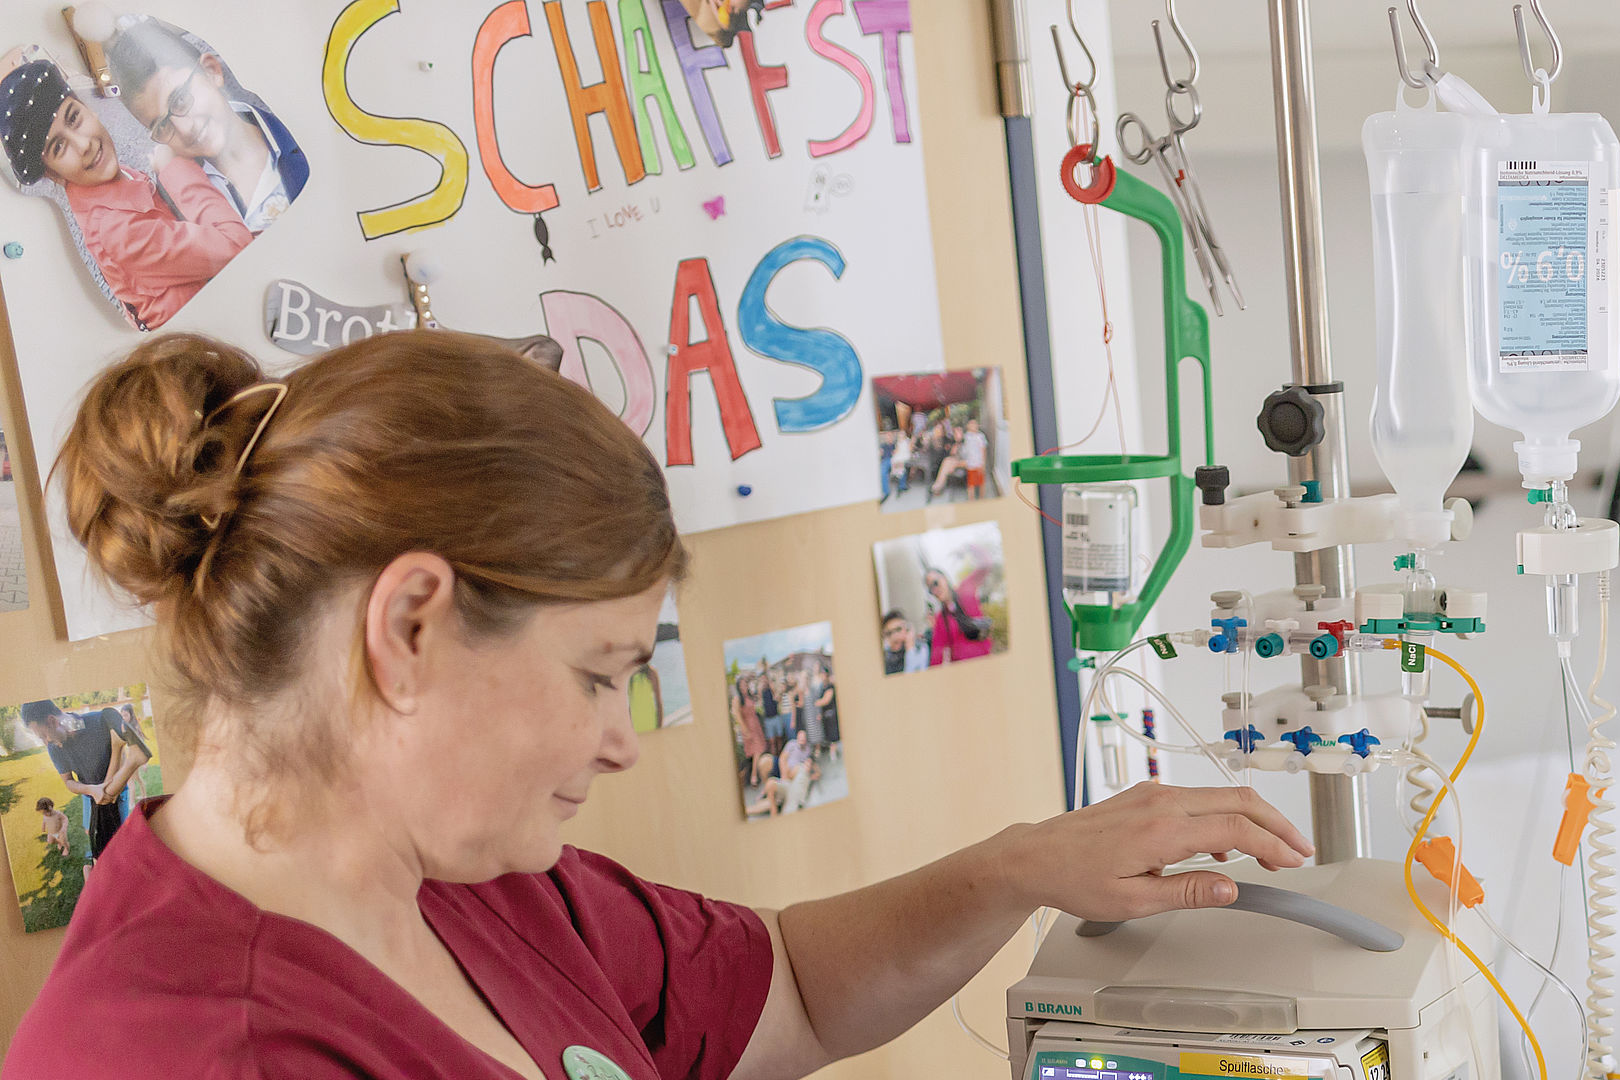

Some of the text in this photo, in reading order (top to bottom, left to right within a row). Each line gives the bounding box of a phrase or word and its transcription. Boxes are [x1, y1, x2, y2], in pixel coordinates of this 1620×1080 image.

[603, 204, 644, 229] LOVE
[272, 281, 419, 348] Brot
[539, 234, 864, 468] DAS
[1408, 643, 1417, 666] NaCl
[1038, 1003, 1083, 1016] BRAUN
[1219, 1059, 1285, 1075] Spülflasche
